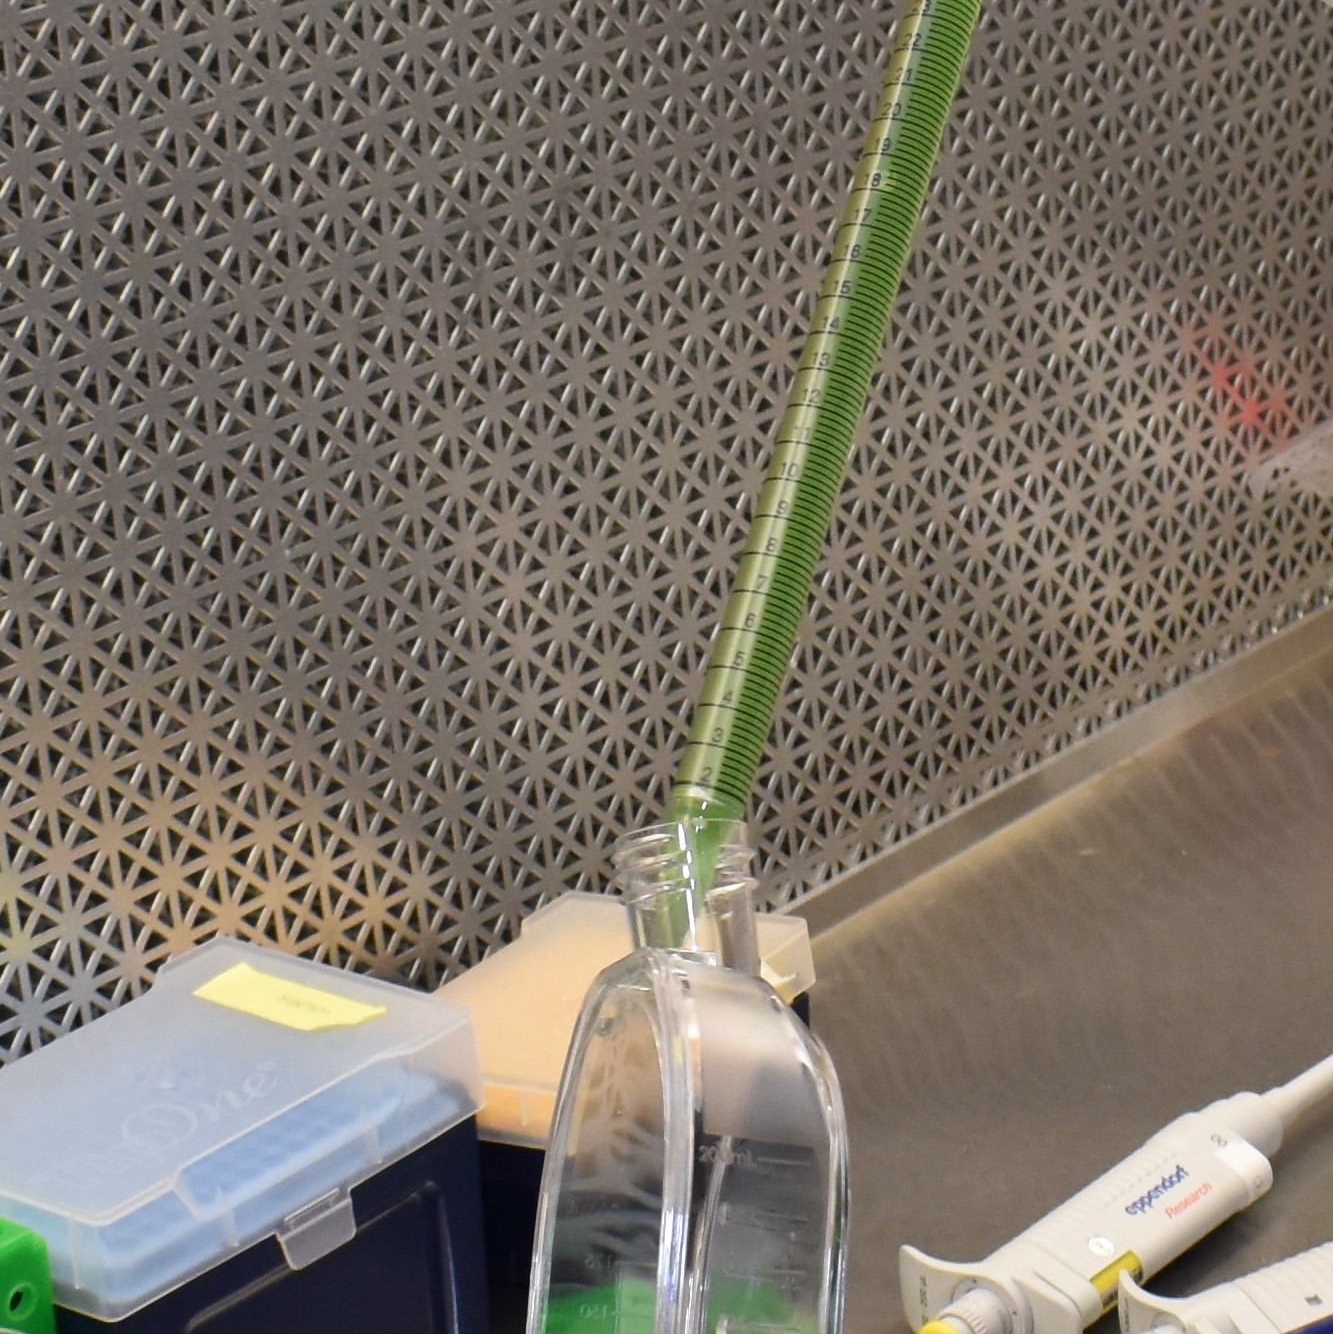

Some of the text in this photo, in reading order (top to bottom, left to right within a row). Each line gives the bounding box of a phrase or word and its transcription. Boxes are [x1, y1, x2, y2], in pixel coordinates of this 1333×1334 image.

[902, 32, 922, 48] 22
[883, 101, 901, 117] 20
[1125, 1164, 1190, 1216] eppendorf
[1165, 1181, 1214, 1218] Research
